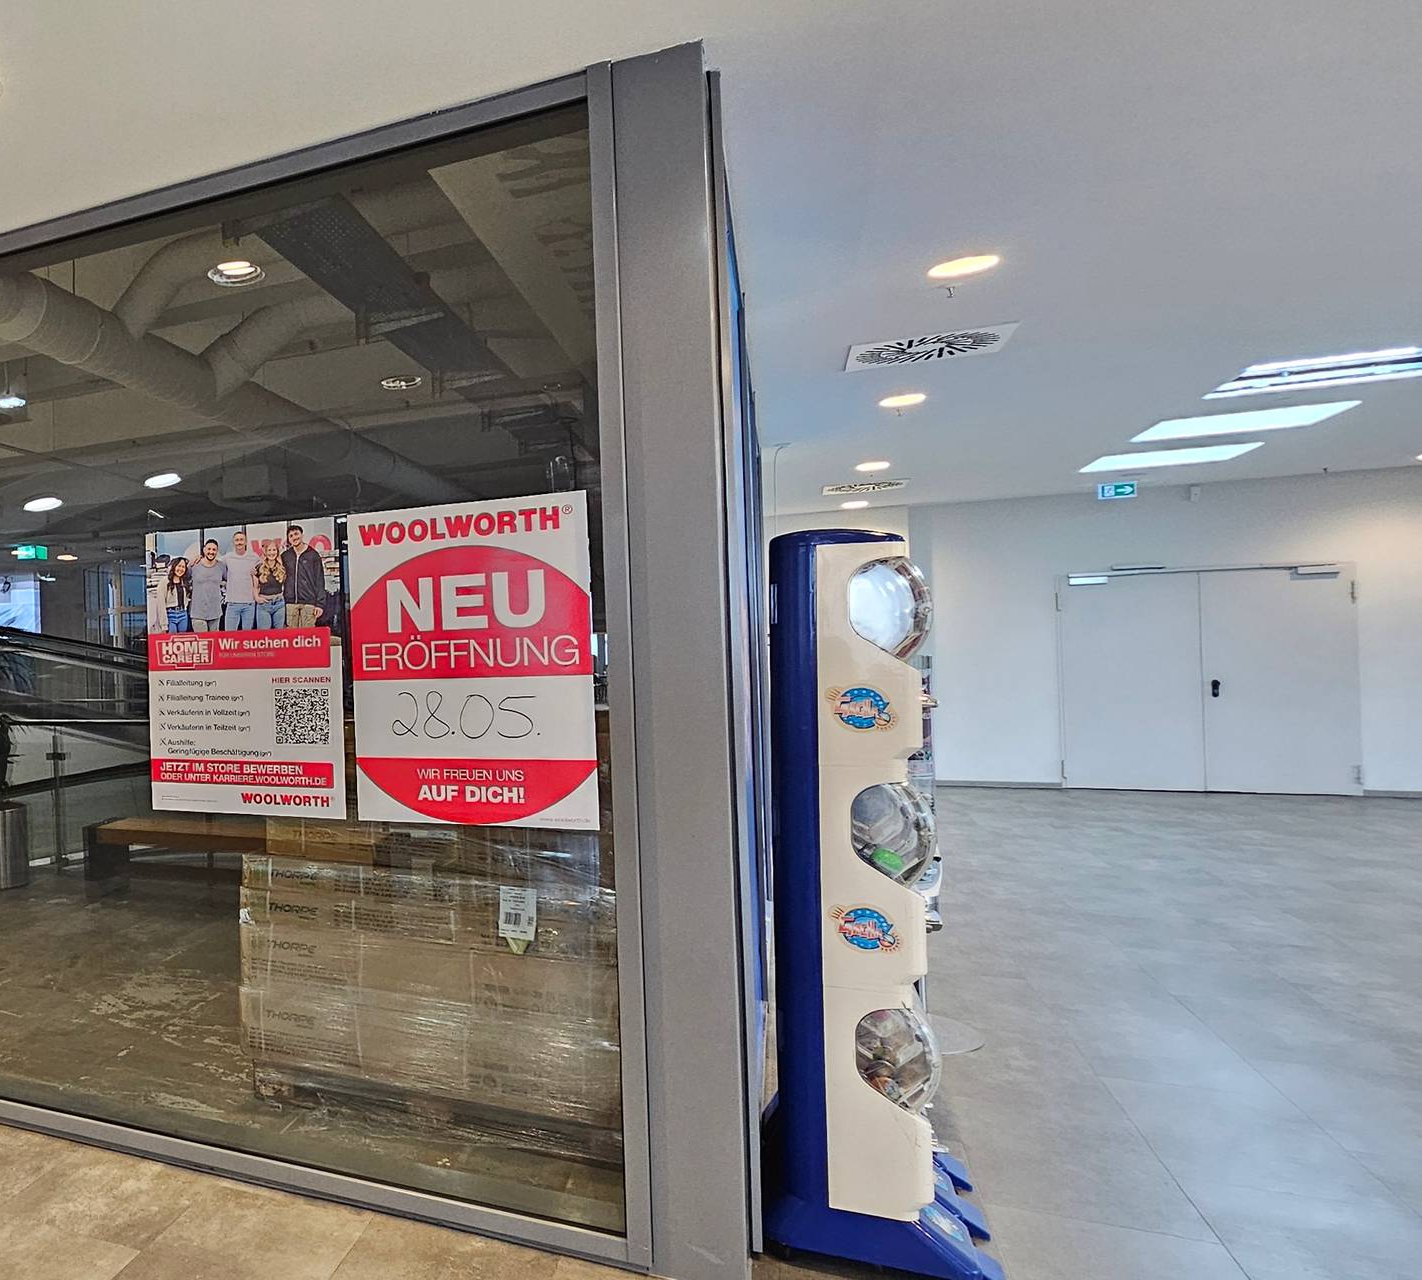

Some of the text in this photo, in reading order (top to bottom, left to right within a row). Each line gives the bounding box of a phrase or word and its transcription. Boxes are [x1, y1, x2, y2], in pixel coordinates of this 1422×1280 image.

[385, 568, 546, 634] NEU
[161, 640, 209, 655] HOME
[218, 634, 322, 650] Wir suchen dich
[162, 653, 210, 664] CAREER
[361, 634, 581, 672] ERÖFFNUNG
[292, 676, 331, 684] SCANNEN
[205, 694, 230, 702] Trainee
[212, 708, 237, 716] Vollzeit
[392, 691, 541, 739] 28.05.
[213, 723, 237, 731] Teilzeit
[160, 762, 303, 775] JETZT IM STORE BEWERBEN
[417, 768, 524, 782] WIR FREUEN UNS
[160, 773, 327, 786] ODER UNTER KARRIERE.WOOLWORTH.DE
[241, 792, 330, 807] WOOLWORTH
[417, 785, 526, 804] AUF DICH!
[268, 902, 319, 915] THORPE
[266, 939, 318, 954] THORPE
